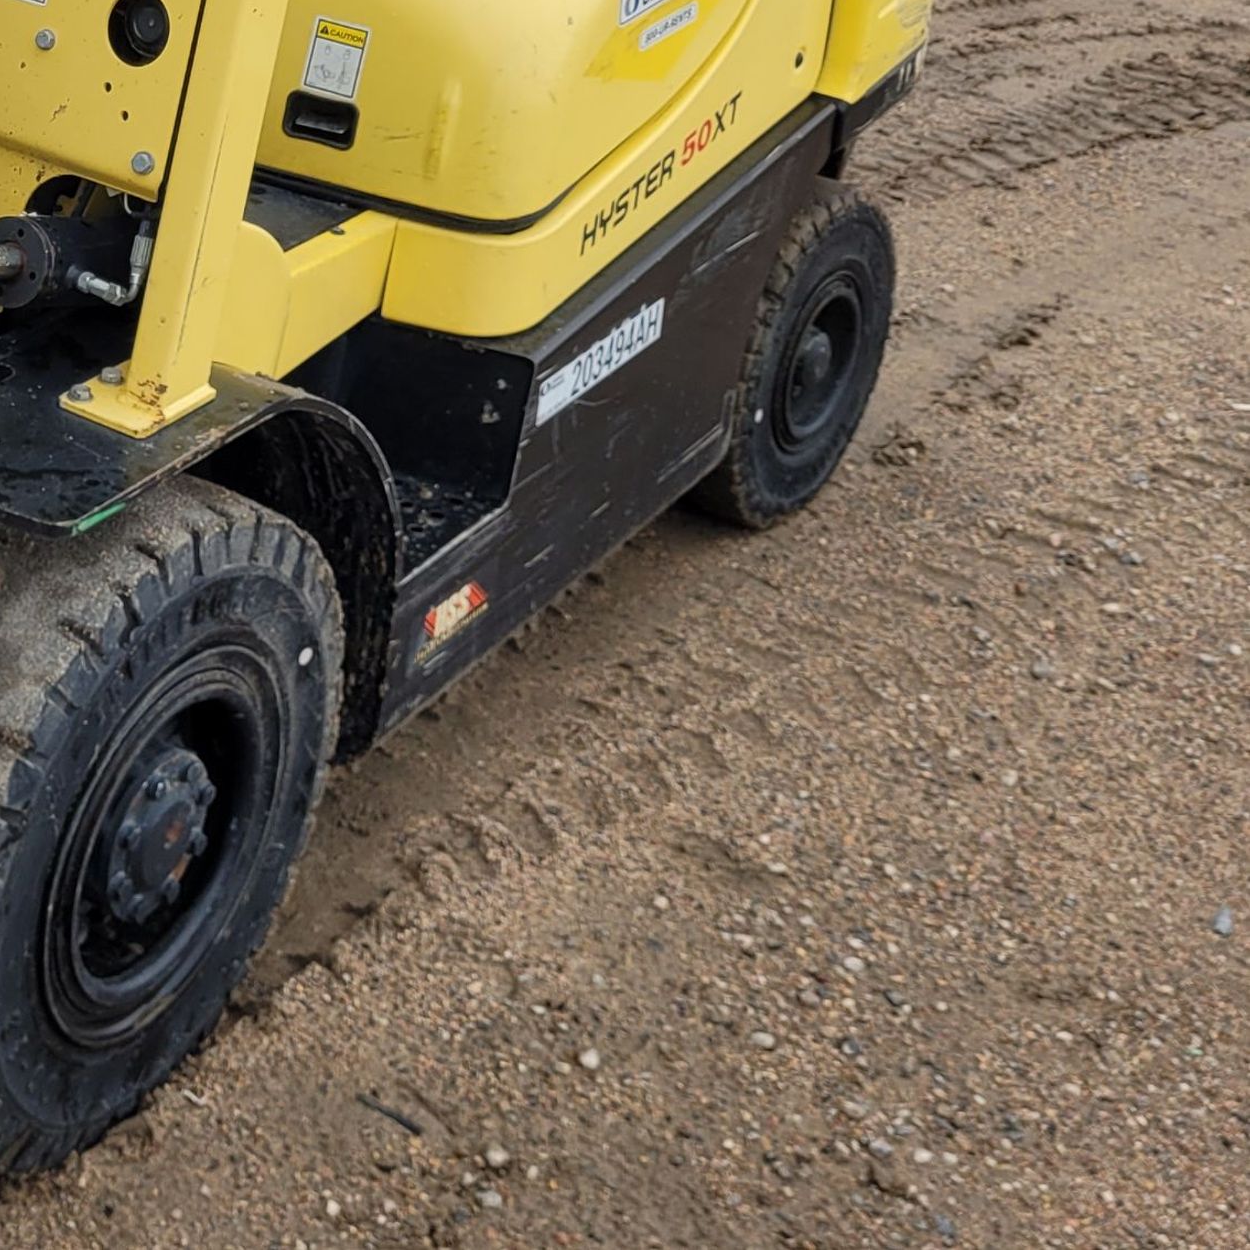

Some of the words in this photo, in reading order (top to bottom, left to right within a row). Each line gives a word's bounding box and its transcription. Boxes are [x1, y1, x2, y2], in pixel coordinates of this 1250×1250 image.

[330, 28, 364, 44] CAUTION
[580, 149, 676, 257] HYSTER
[681, 90, 743, 166] 50XT
[571, 303, 661, 397] 203494AH
